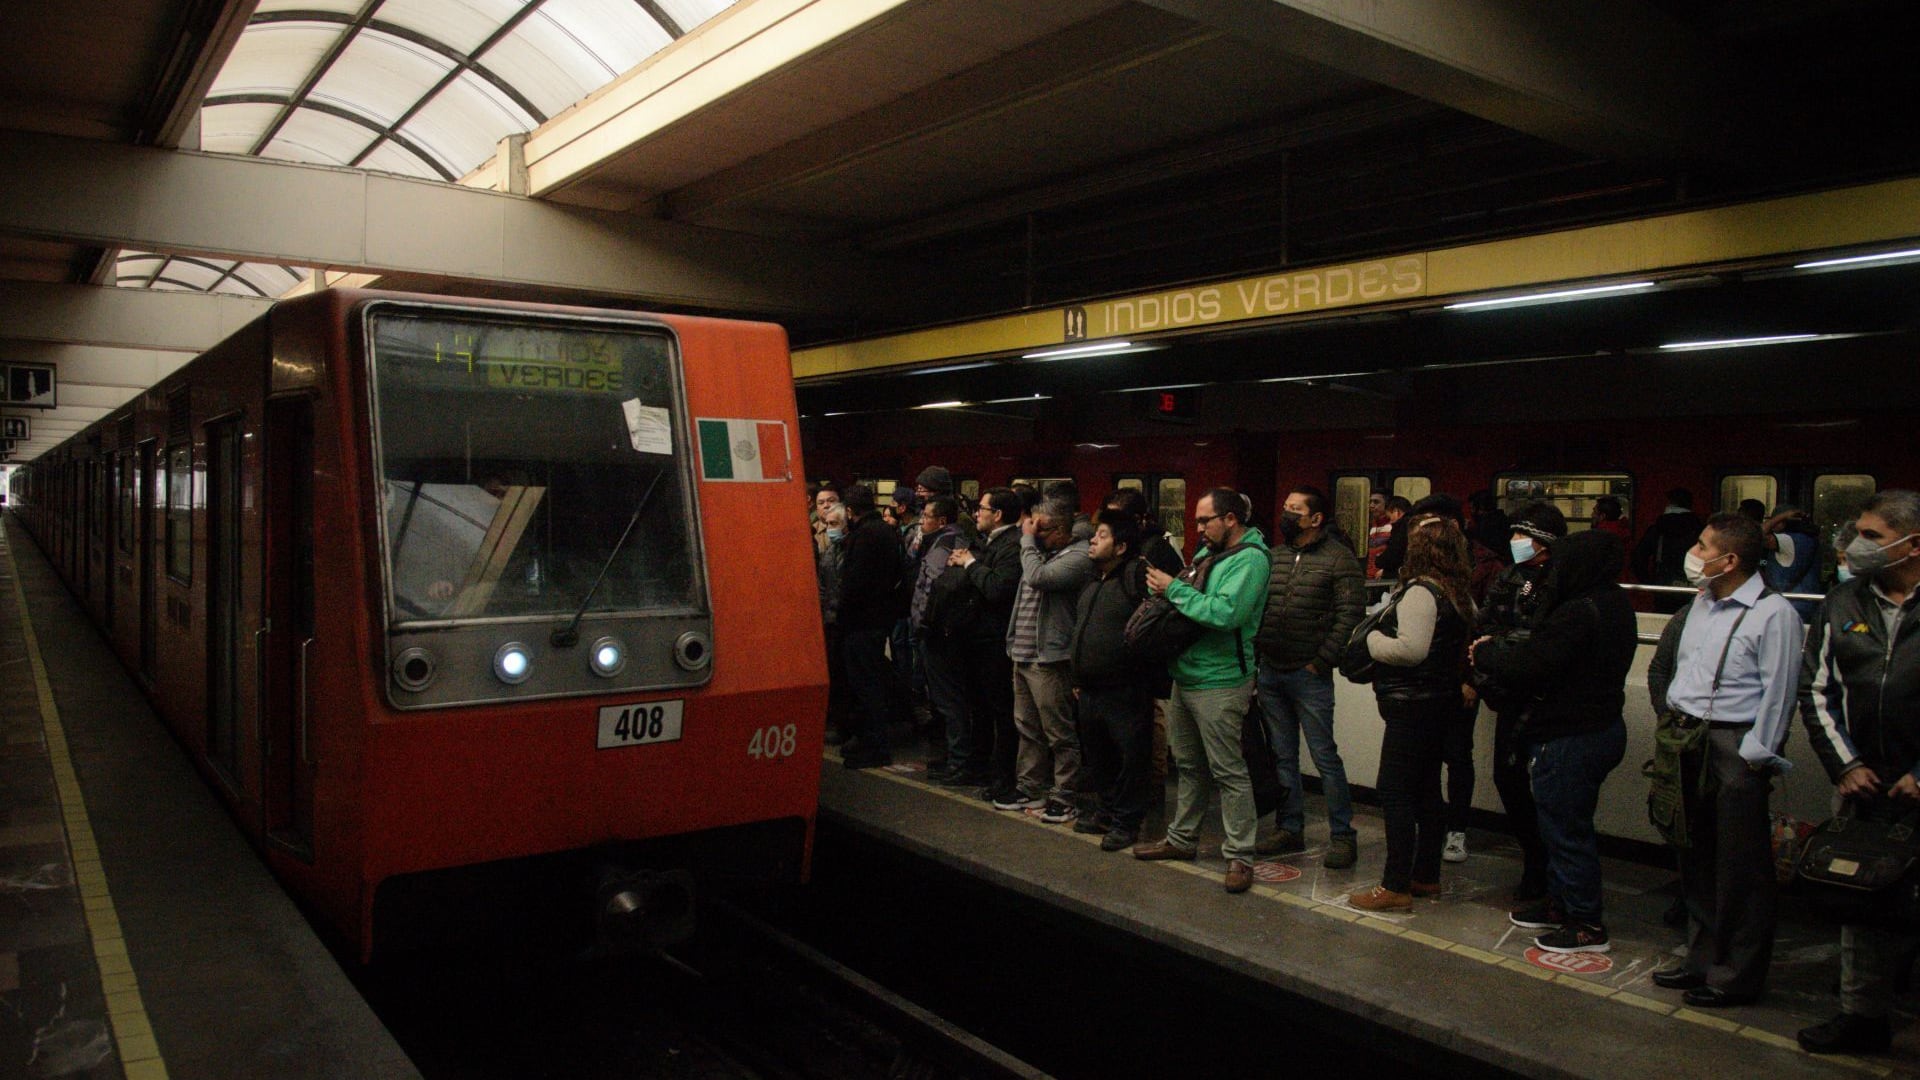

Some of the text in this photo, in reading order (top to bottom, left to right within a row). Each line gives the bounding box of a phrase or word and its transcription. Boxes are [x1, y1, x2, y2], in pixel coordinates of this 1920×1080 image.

[1105, 258, 1422, 333] INDIOS VERDES
[500, 363, 623, 391] VERDES
[615, 706, 663, 740] 408
[747, 723, 797, 759] 408
